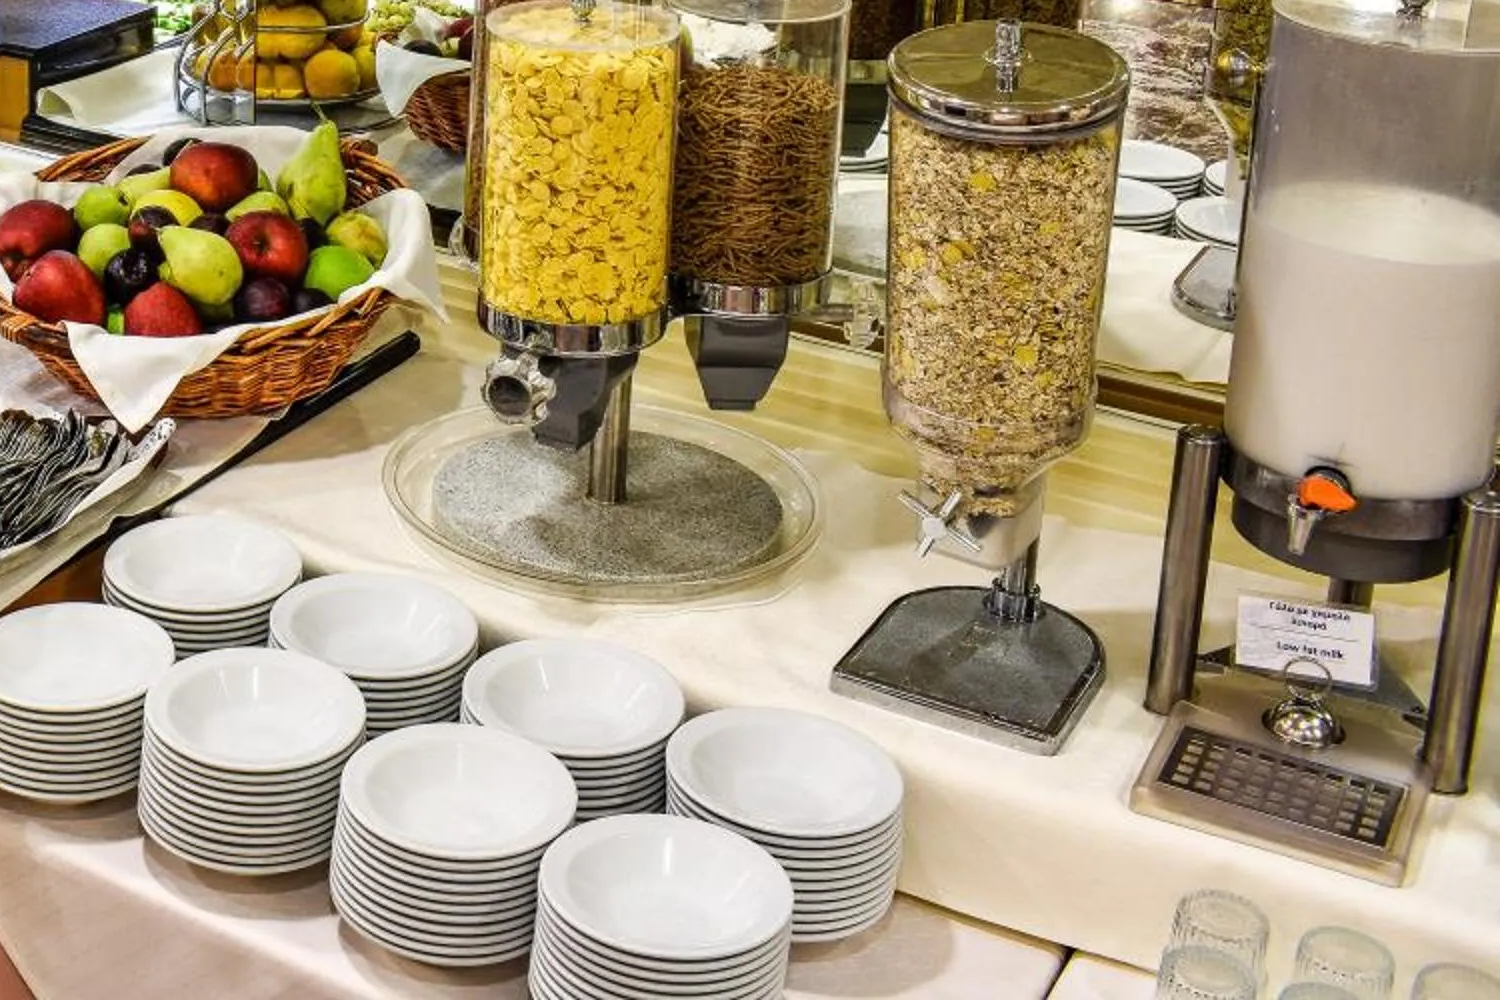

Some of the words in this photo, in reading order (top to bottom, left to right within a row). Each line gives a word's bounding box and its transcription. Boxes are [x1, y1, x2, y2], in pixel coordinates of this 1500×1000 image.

[1276, 640, 1300, 652] Low
[1302, 645, 1317, 655] fat
[1319, 649, 1344, 659] milk
